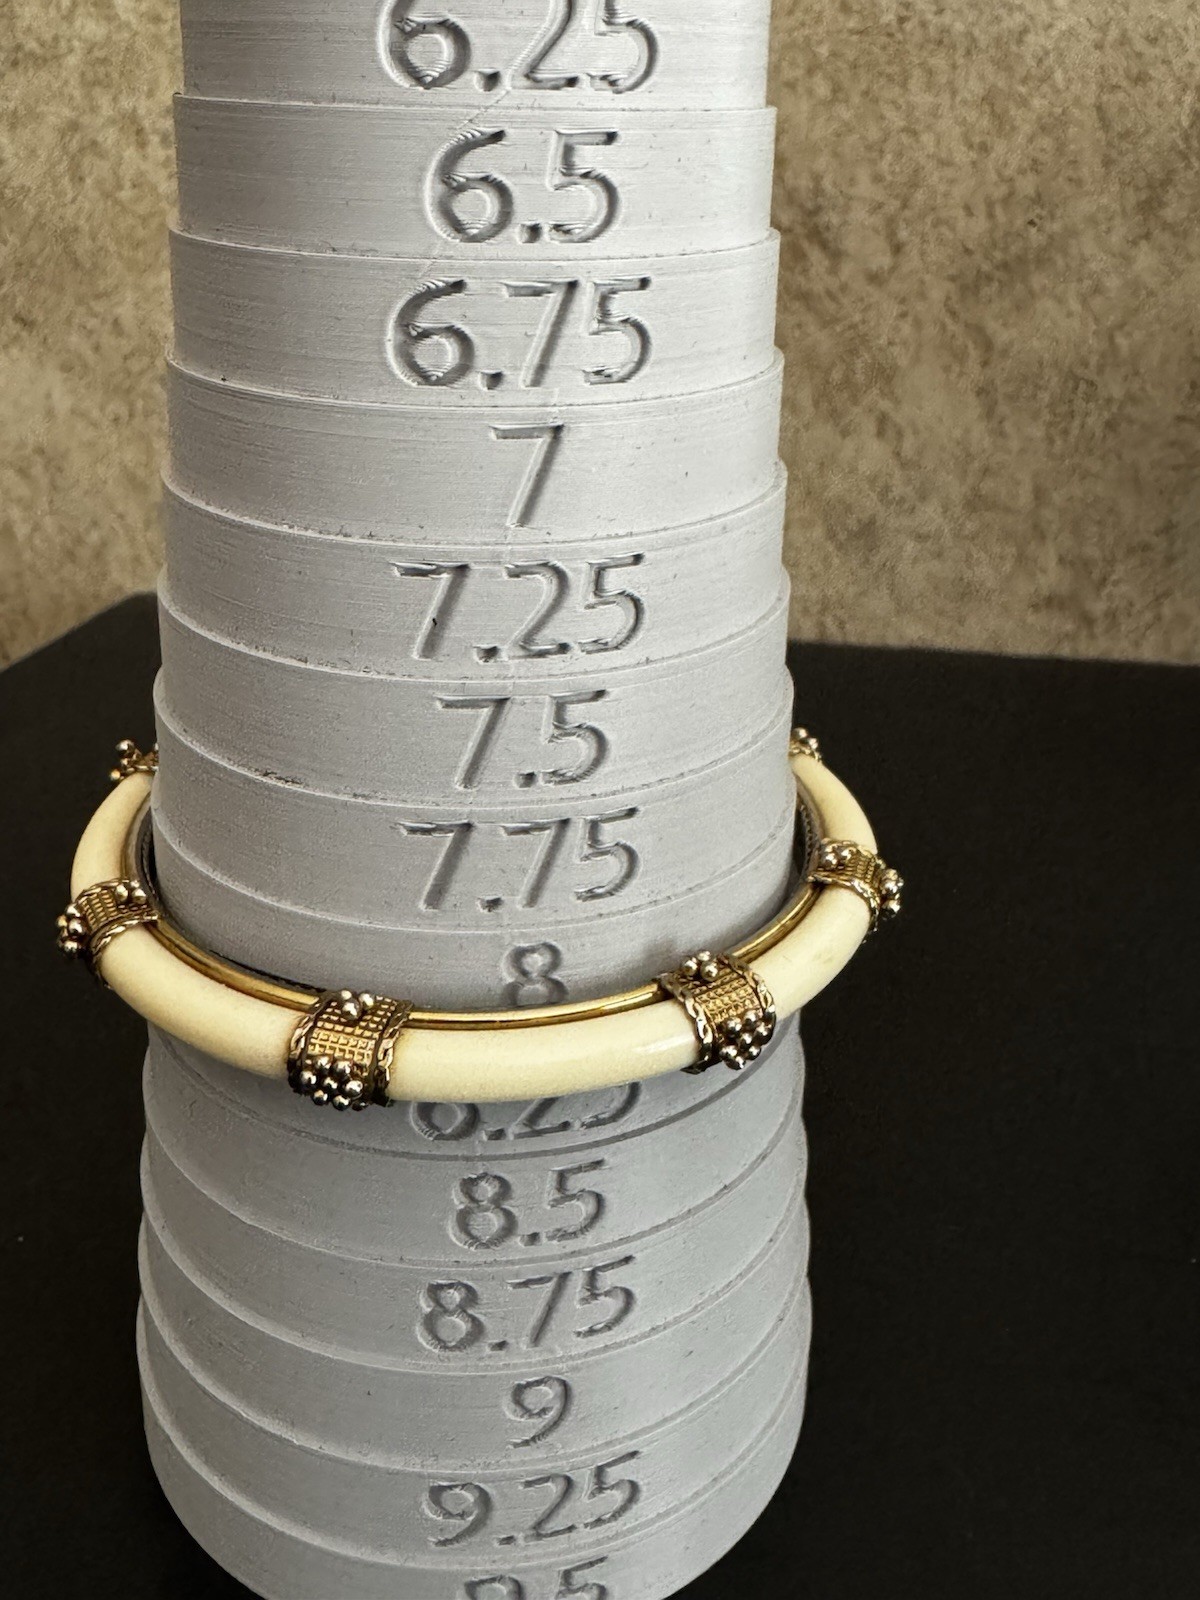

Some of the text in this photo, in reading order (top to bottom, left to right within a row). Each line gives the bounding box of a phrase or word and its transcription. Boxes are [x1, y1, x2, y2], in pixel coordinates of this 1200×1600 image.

[376, 0, 660, 94] 6.25
[424, 127, 621, 244] 6.5
[386, 277, 652, 390] 6.75
[489, 422, 565, 528] 7
[390, 552, 645, 663] 7.25
[434, 689, 611, 790] 7.5
[399, 806, 641, 913] 7.75
[502, 942, 568, 1007] 8
[449, 1158, 607, 1250] 8.5
[417, 1254, 637, 1353] 8.75
[505, 1376, 572, 1449] 9
[421, 1450, 642, 1547] 9.25
